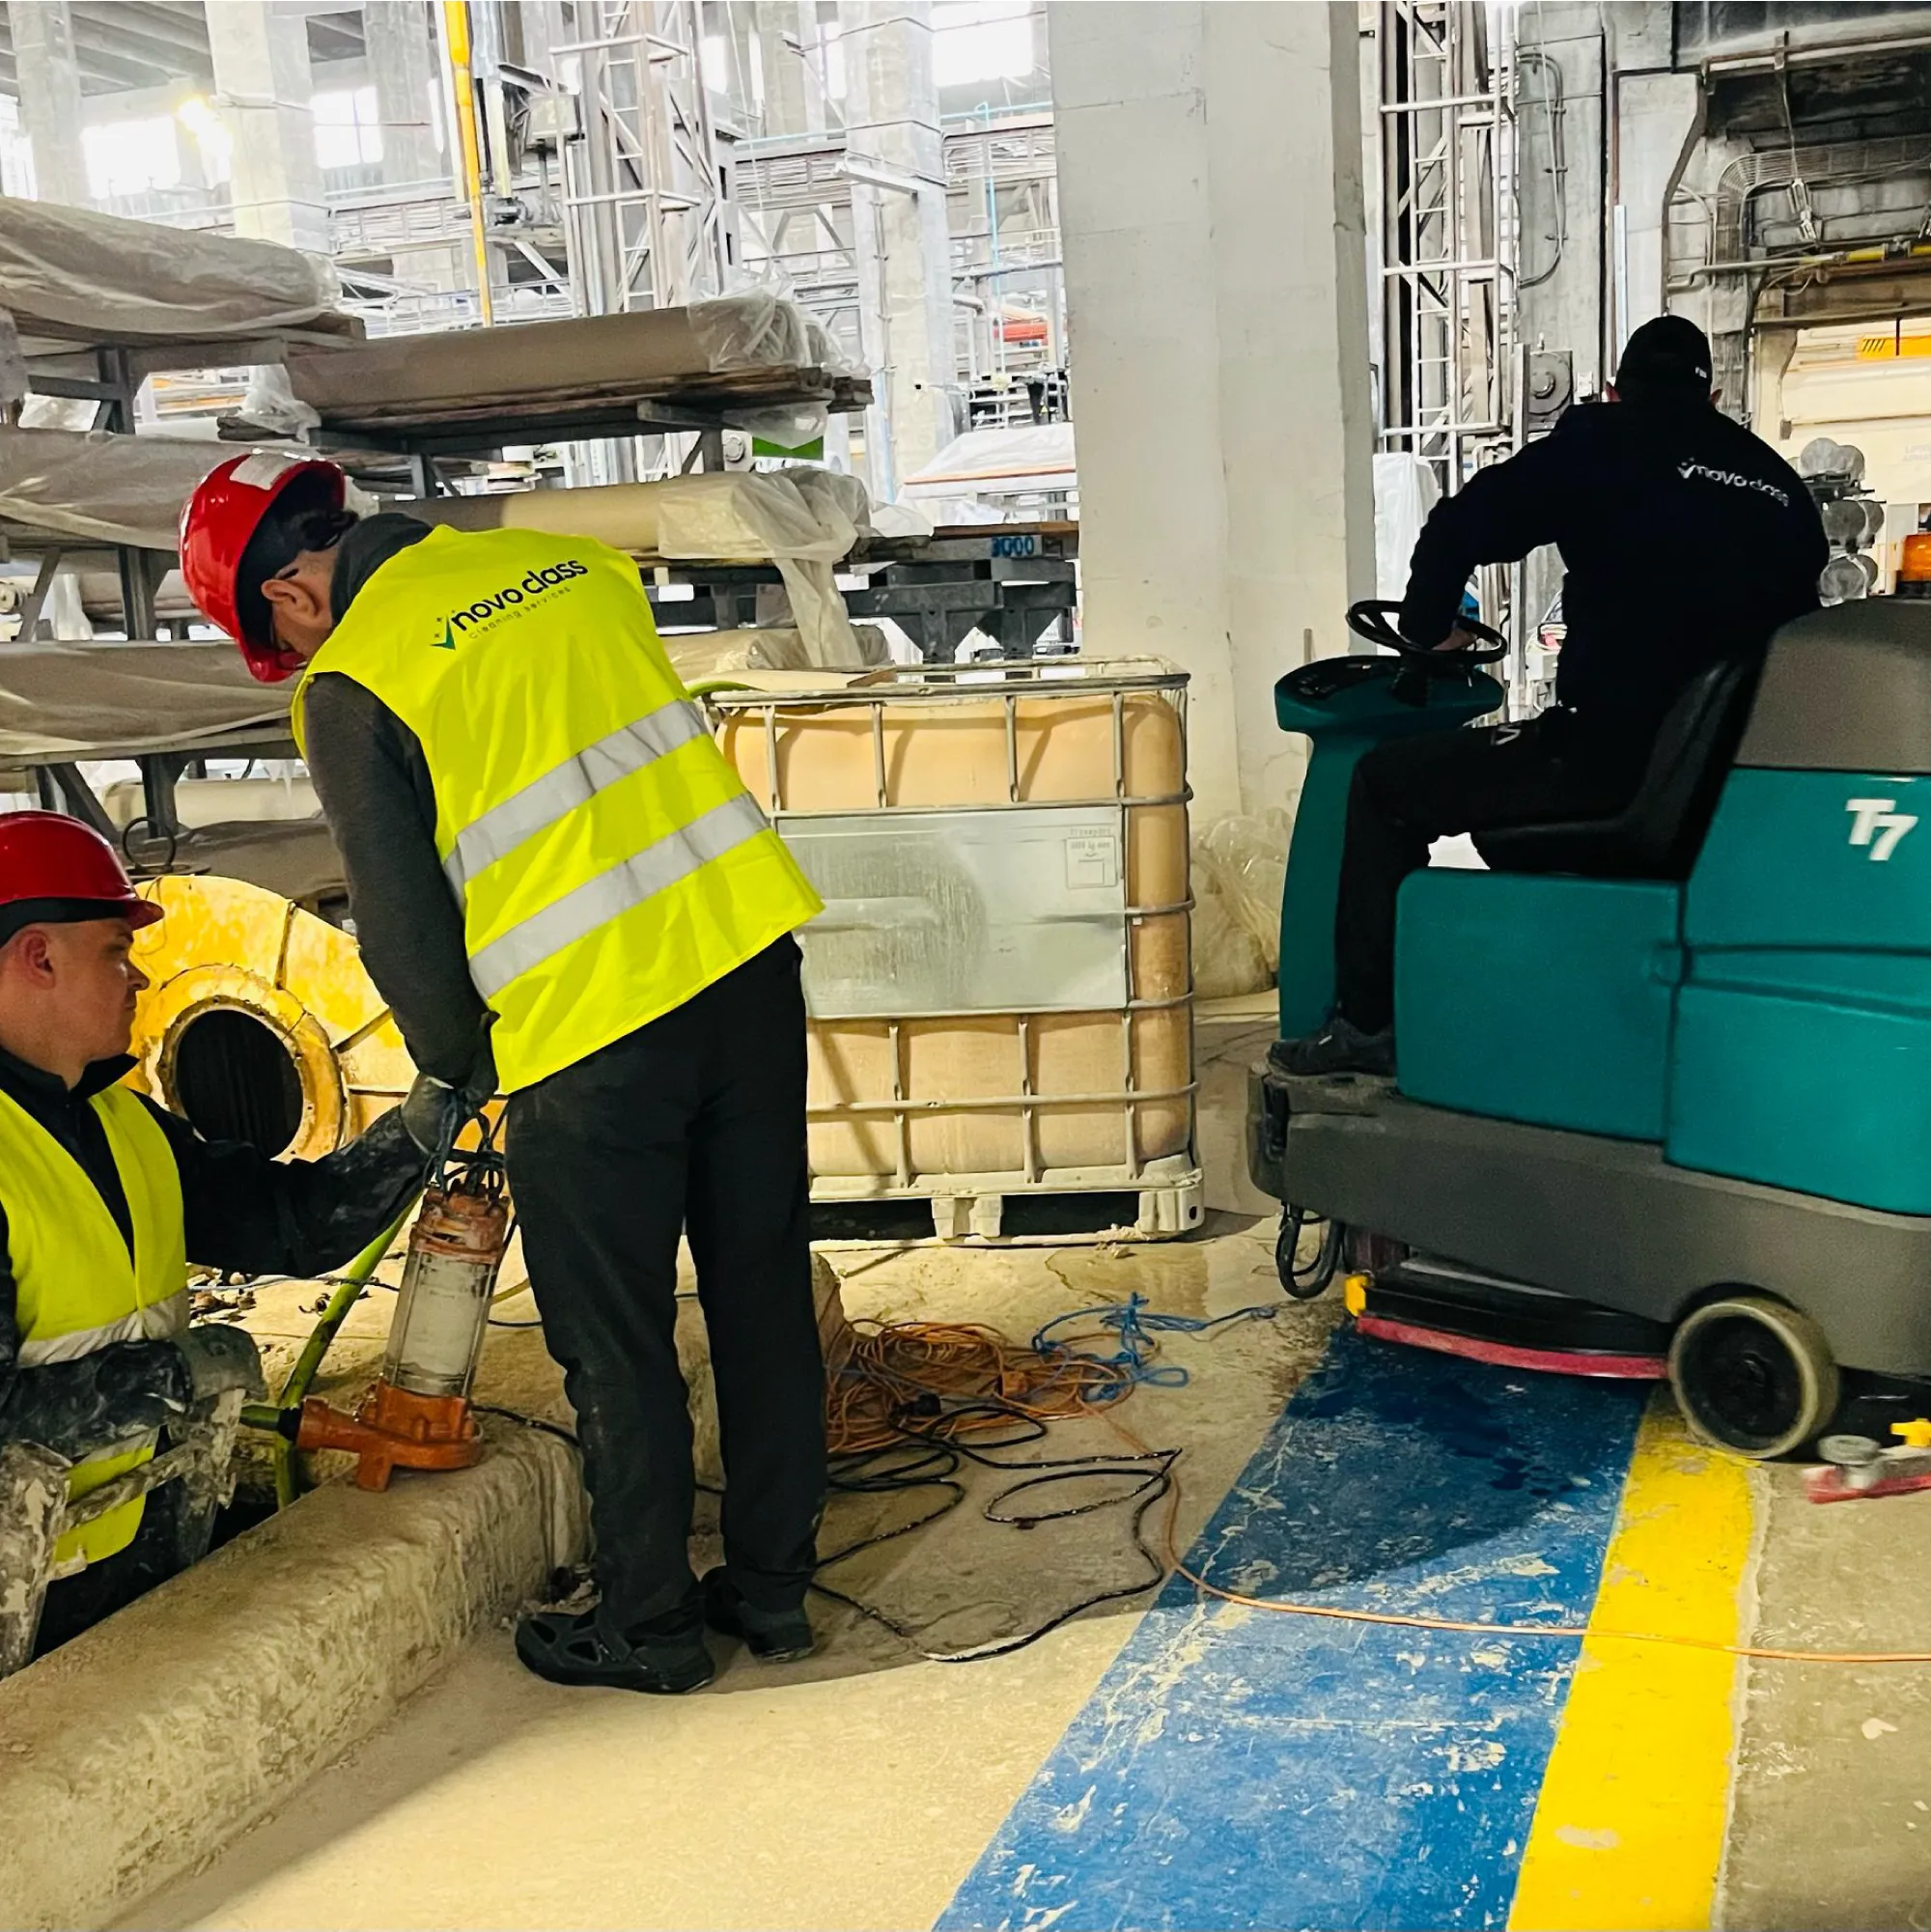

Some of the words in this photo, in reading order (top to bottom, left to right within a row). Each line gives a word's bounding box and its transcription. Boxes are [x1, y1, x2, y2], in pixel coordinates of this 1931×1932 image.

[1695, 464, 1748, 488] novo
[451, 588, 524, 631] novo
[521, 559, 588, 595] class
[523, 586, 572, 612] services
[1845, 798, 1919, 861] T7
